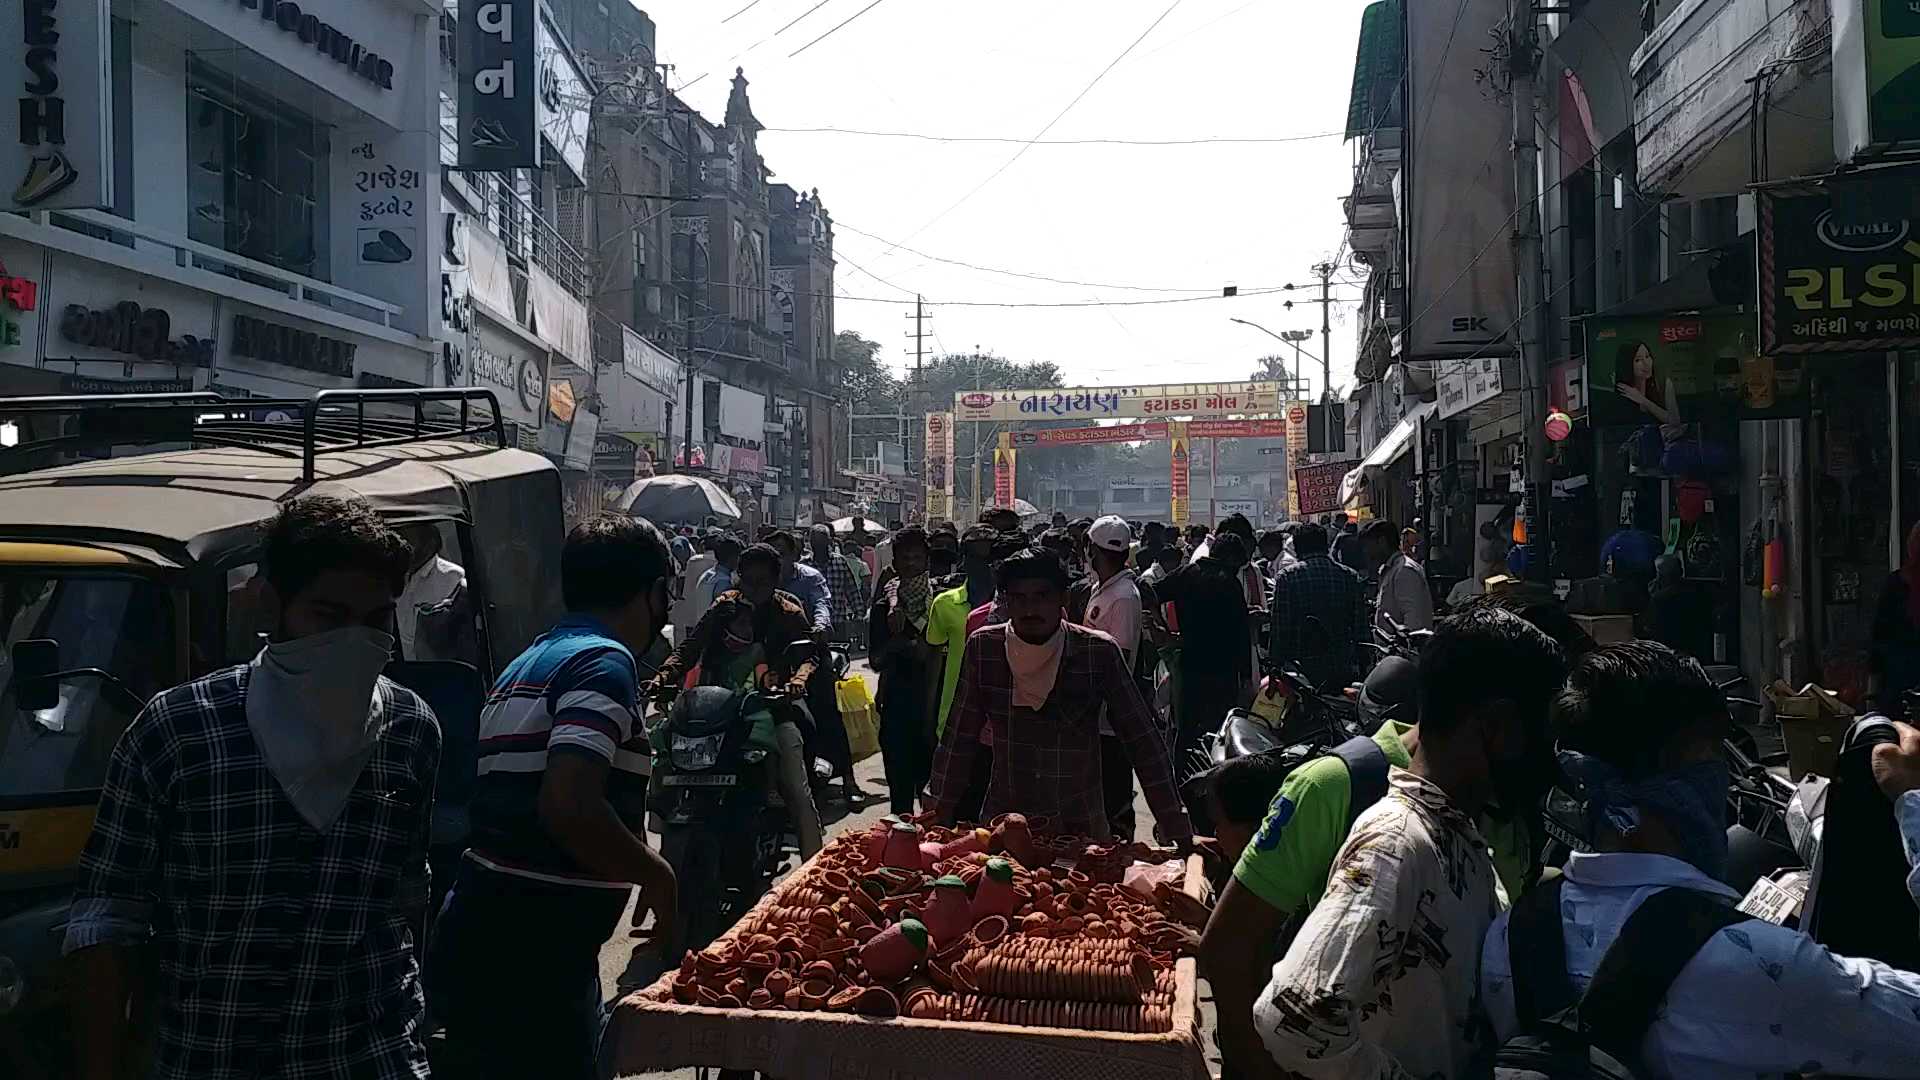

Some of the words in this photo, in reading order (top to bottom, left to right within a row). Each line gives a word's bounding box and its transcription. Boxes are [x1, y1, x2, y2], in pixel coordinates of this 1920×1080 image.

[354, 164, 420, 193] રાજેશ
[1452, 315, 1489, 332] SK
[1853, 319, 1870, 334] જ
[1206, 393, 1237, 411] મોલ
